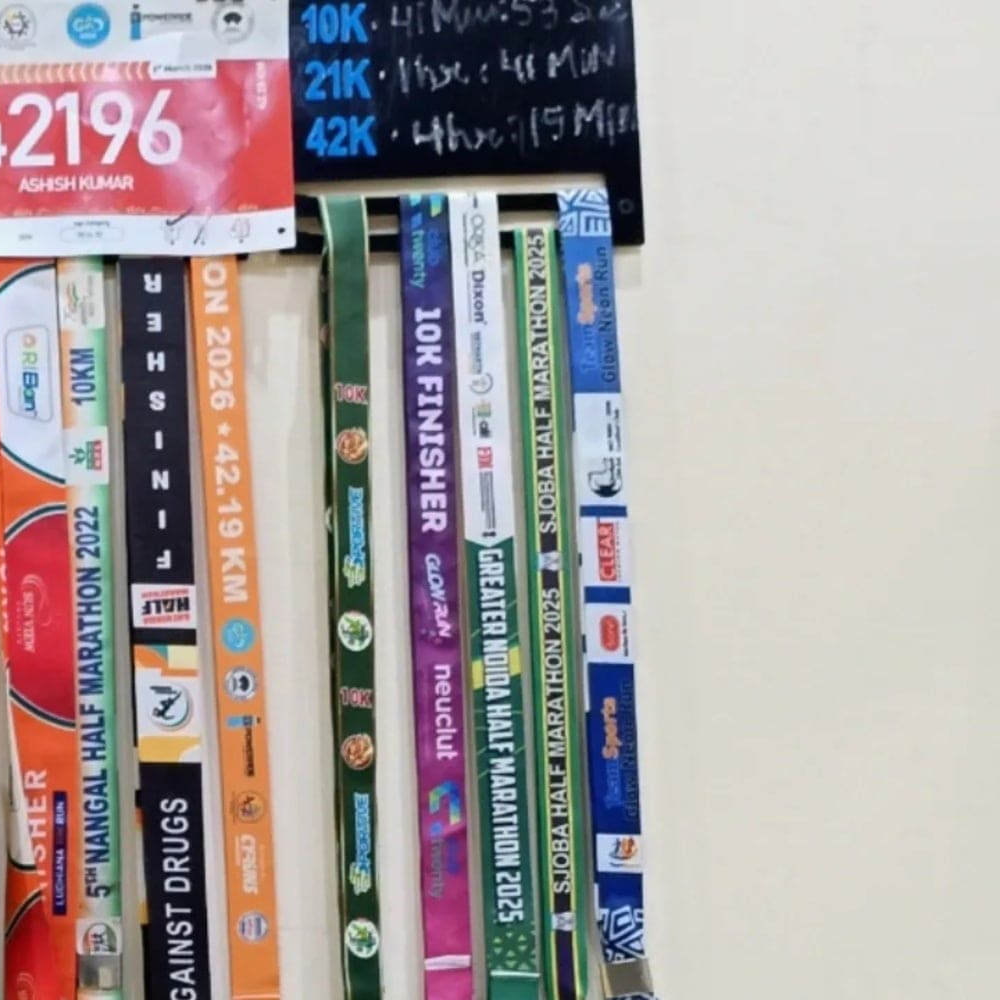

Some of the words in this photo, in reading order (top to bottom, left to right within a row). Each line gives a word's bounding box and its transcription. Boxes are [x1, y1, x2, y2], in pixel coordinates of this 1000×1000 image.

[301, 3, 369, 44] 10K
[304, 59, 372, 100] 21K
[305, 115, 377, 156] 42K
[18, 176, 77, 193] ASHISH
[79, 174, 135, 192] KUMAR
[529, 234, 545, 279] 2025
[594, 246, 609, 282] Run
[471, 269, 487, 323] Dixon
[598, 286, 613, 333] Neon
[415, 307, 442, 367] 10K
[530, 280, 552, 401] MARATHON
[601, 339, 617, 384] Glow
[69, 347, 96, 407] 10KM
[206, 326, 235, 412] 2026
[334, 383, 368, 404] 10K
[417, 373, 448, 534] FINISHER
[534, 405, 554, 461] HALF
[214, 443, 243, 539] 42.19
[538, 465, 558, 535] SJOBA
[75, 506, 99, 558] 2022
[599, 524, 615, 580] CLEAR
[220, 547, 249, 604] KM
[477, 548, 505, 635] GREATER
[76, 561, 106, 688] MARATHON
[141, 597, 190, 615] HALF
[542, 588, 560, 634] 2025
[340, 686, 373, 708] 10K
[483, 637, 507, 702] NOIDA
[544, 635, 567, 755] MARATHON
[81, 702, 108, 762] HALF
[434, 663, 459, 760] neuclut
[486, 703, 513, 748] HALF
[83, 769, 109, 861] NANGAL
[490, 750, 521, 869] MARATHON
[549, 760, 567, 817] HALF
[161, 797, 191, 892] DRUGS
[553, 820, 572, 895] SJOBA
[496, 871, 524, 923] 2025
